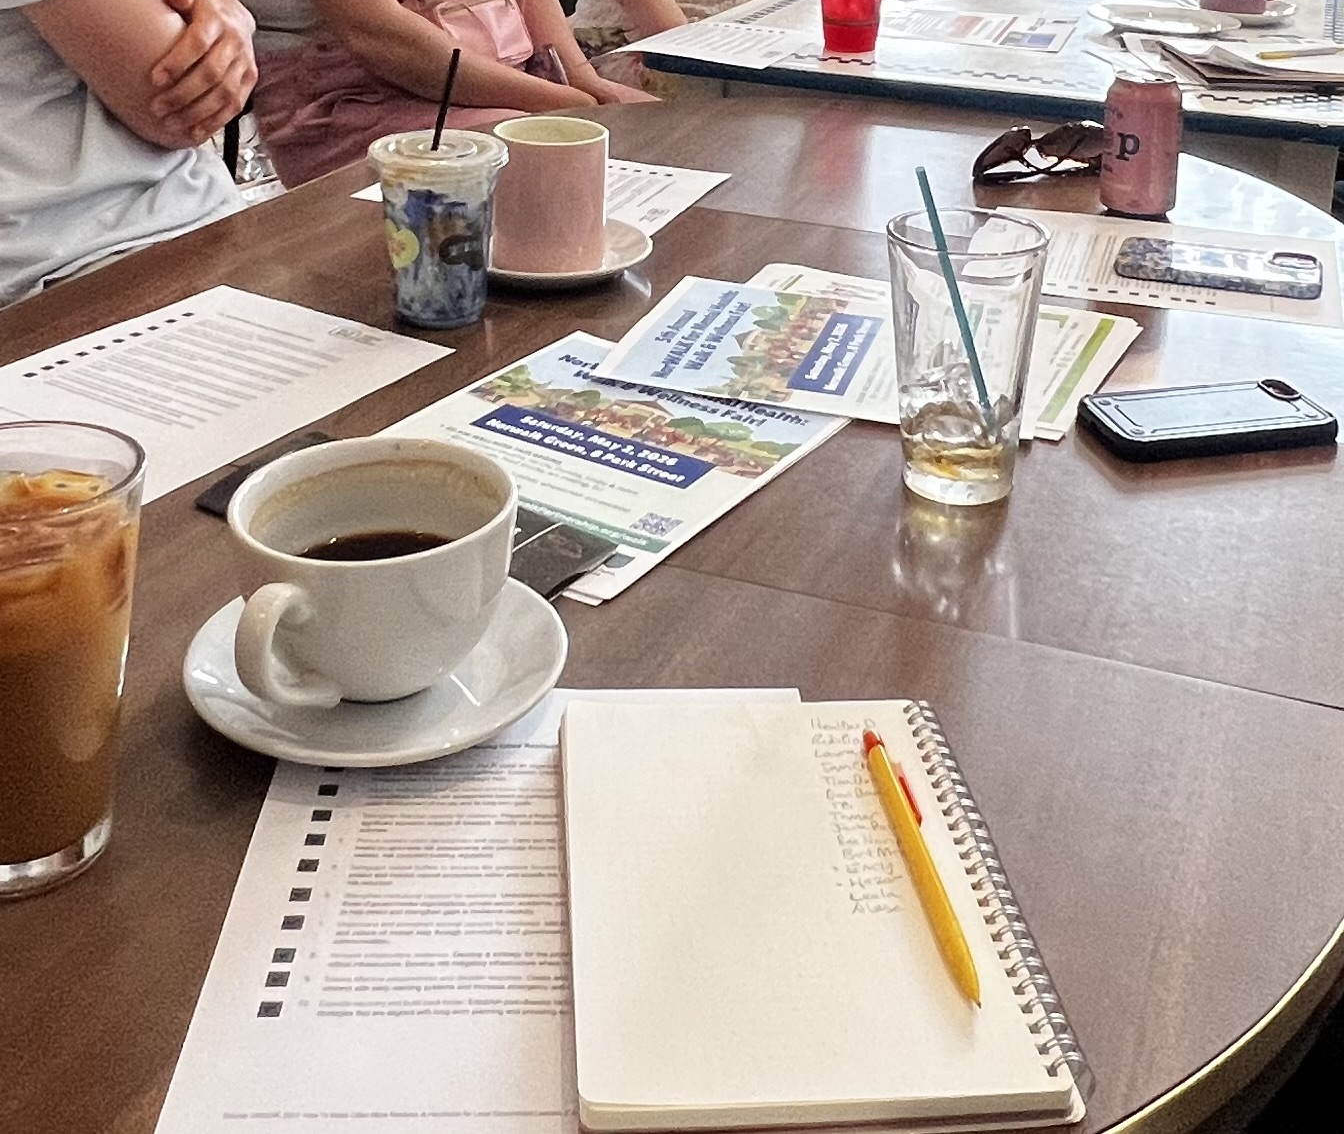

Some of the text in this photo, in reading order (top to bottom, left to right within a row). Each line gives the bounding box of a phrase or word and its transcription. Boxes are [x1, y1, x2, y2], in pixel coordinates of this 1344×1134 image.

[638, 383, 718, 415] Wellness
[719, 406, 767, 428] Fair!
[485, 417, 544, 445] Norwalk
[544, 432, 587, 457] Green,
[602, 449, 638, 471] Park
[637, 462, 686, 484] Street
[518, 414, 678, 467] Saturday, May 2, 2026
